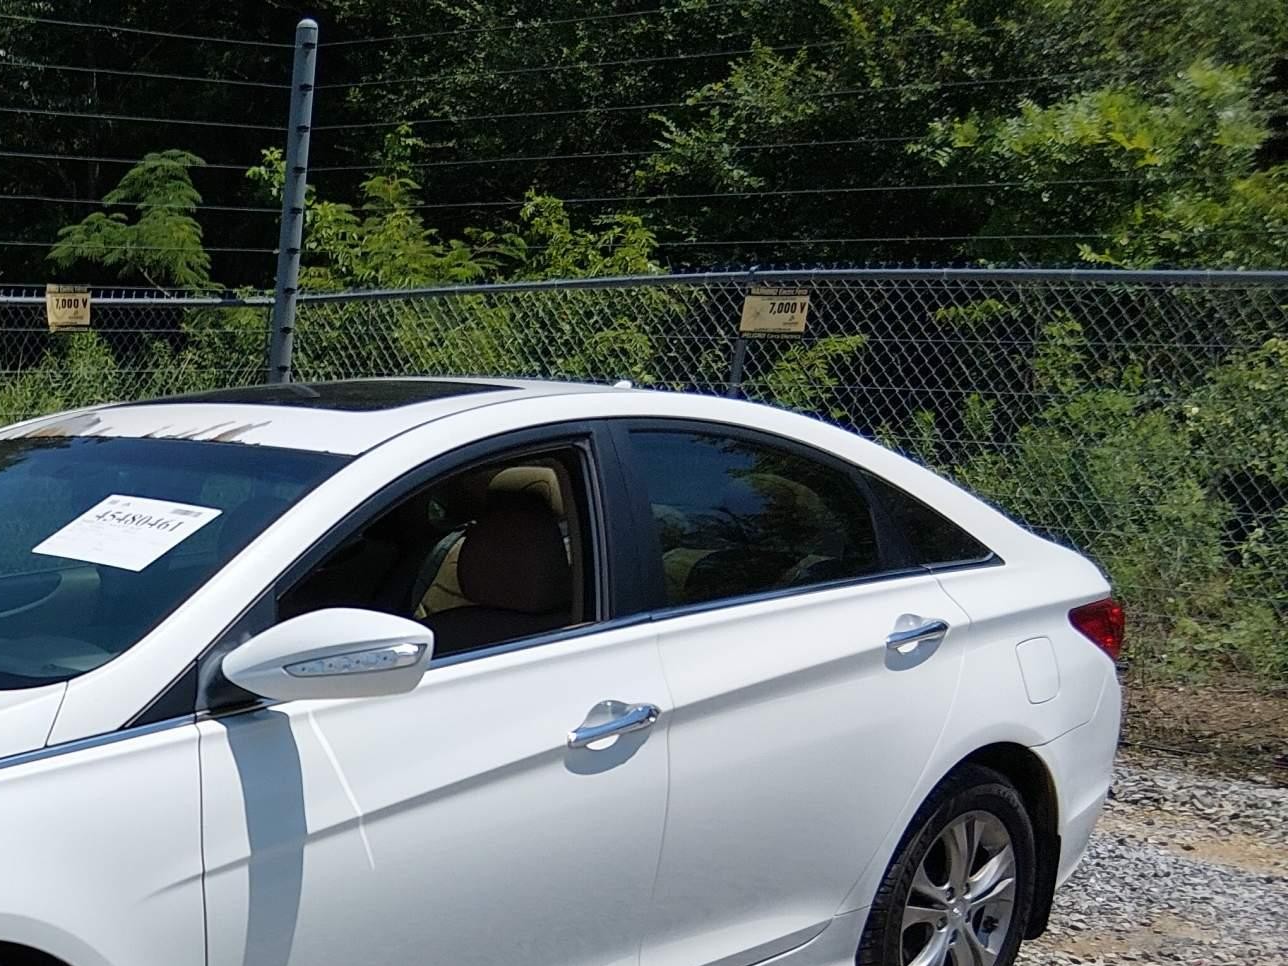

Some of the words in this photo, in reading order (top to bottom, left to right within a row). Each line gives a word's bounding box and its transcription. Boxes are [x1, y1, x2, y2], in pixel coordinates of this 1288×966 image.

[55, 298, 79, 311] 7,000
[82, 298, 88, 309] V
[769, 302, 797, 315] 7,000
[95, 510, 185, 532] 45480461
